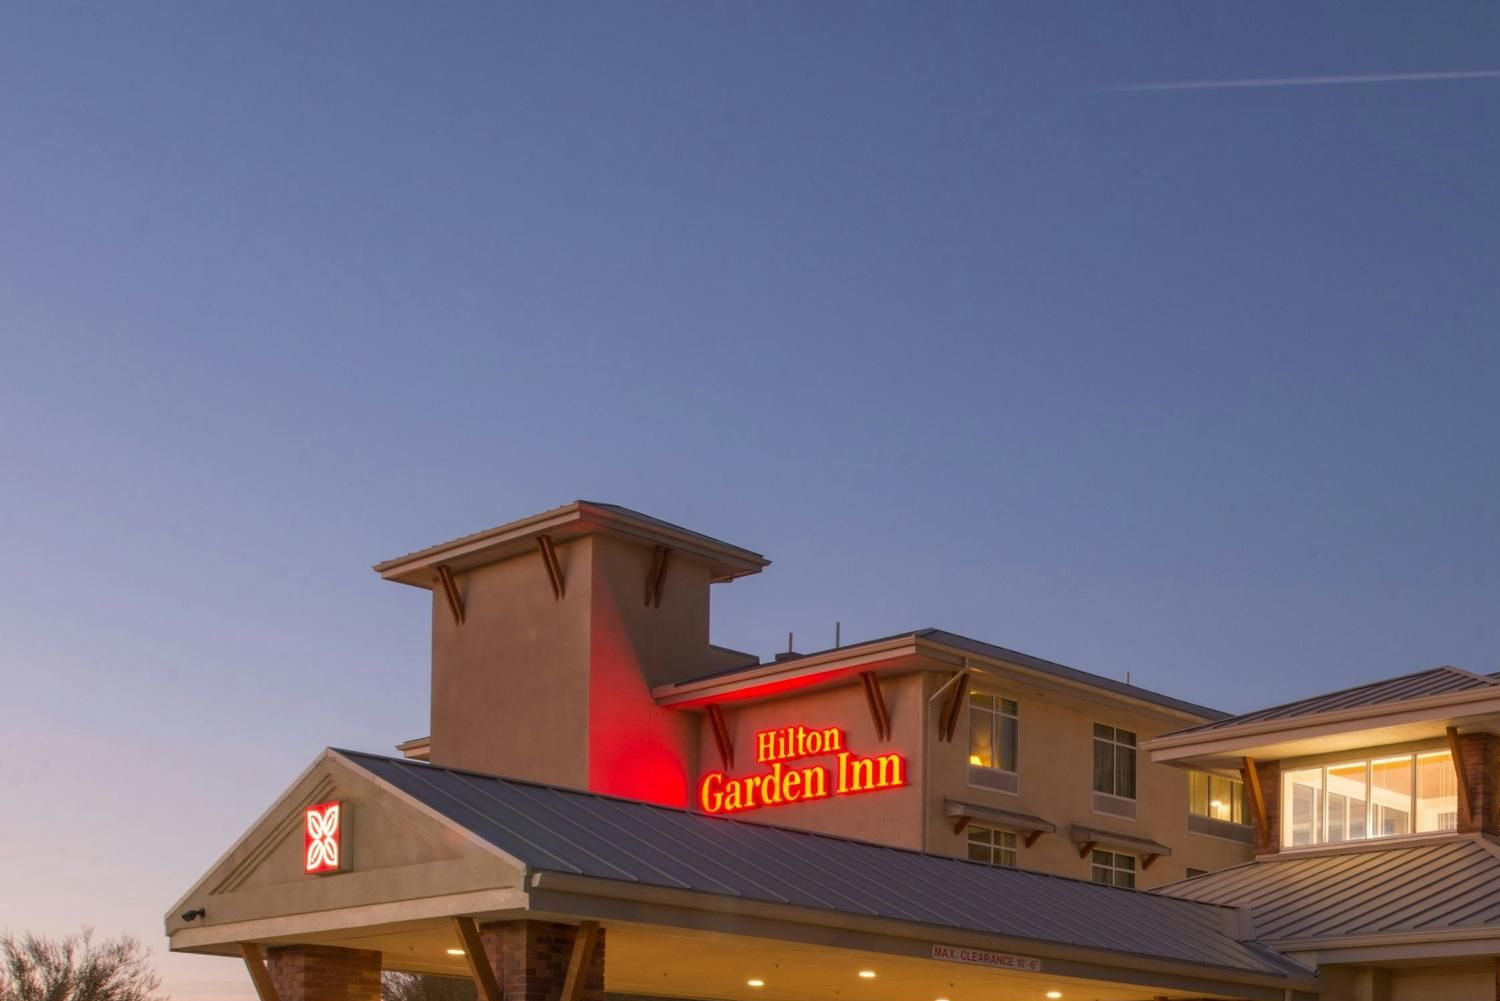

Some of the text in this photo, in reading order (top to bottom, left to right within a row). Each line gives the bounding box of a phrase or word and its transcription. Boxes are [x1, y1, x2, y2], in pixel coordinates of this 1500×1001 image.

[756, 726, 841, 763] Hilton
[701, 752, 903, 813] Garden Inn
[934, 946, 957, 960] MAX.
[960, 950, 1014, 967] CLEARANCE
